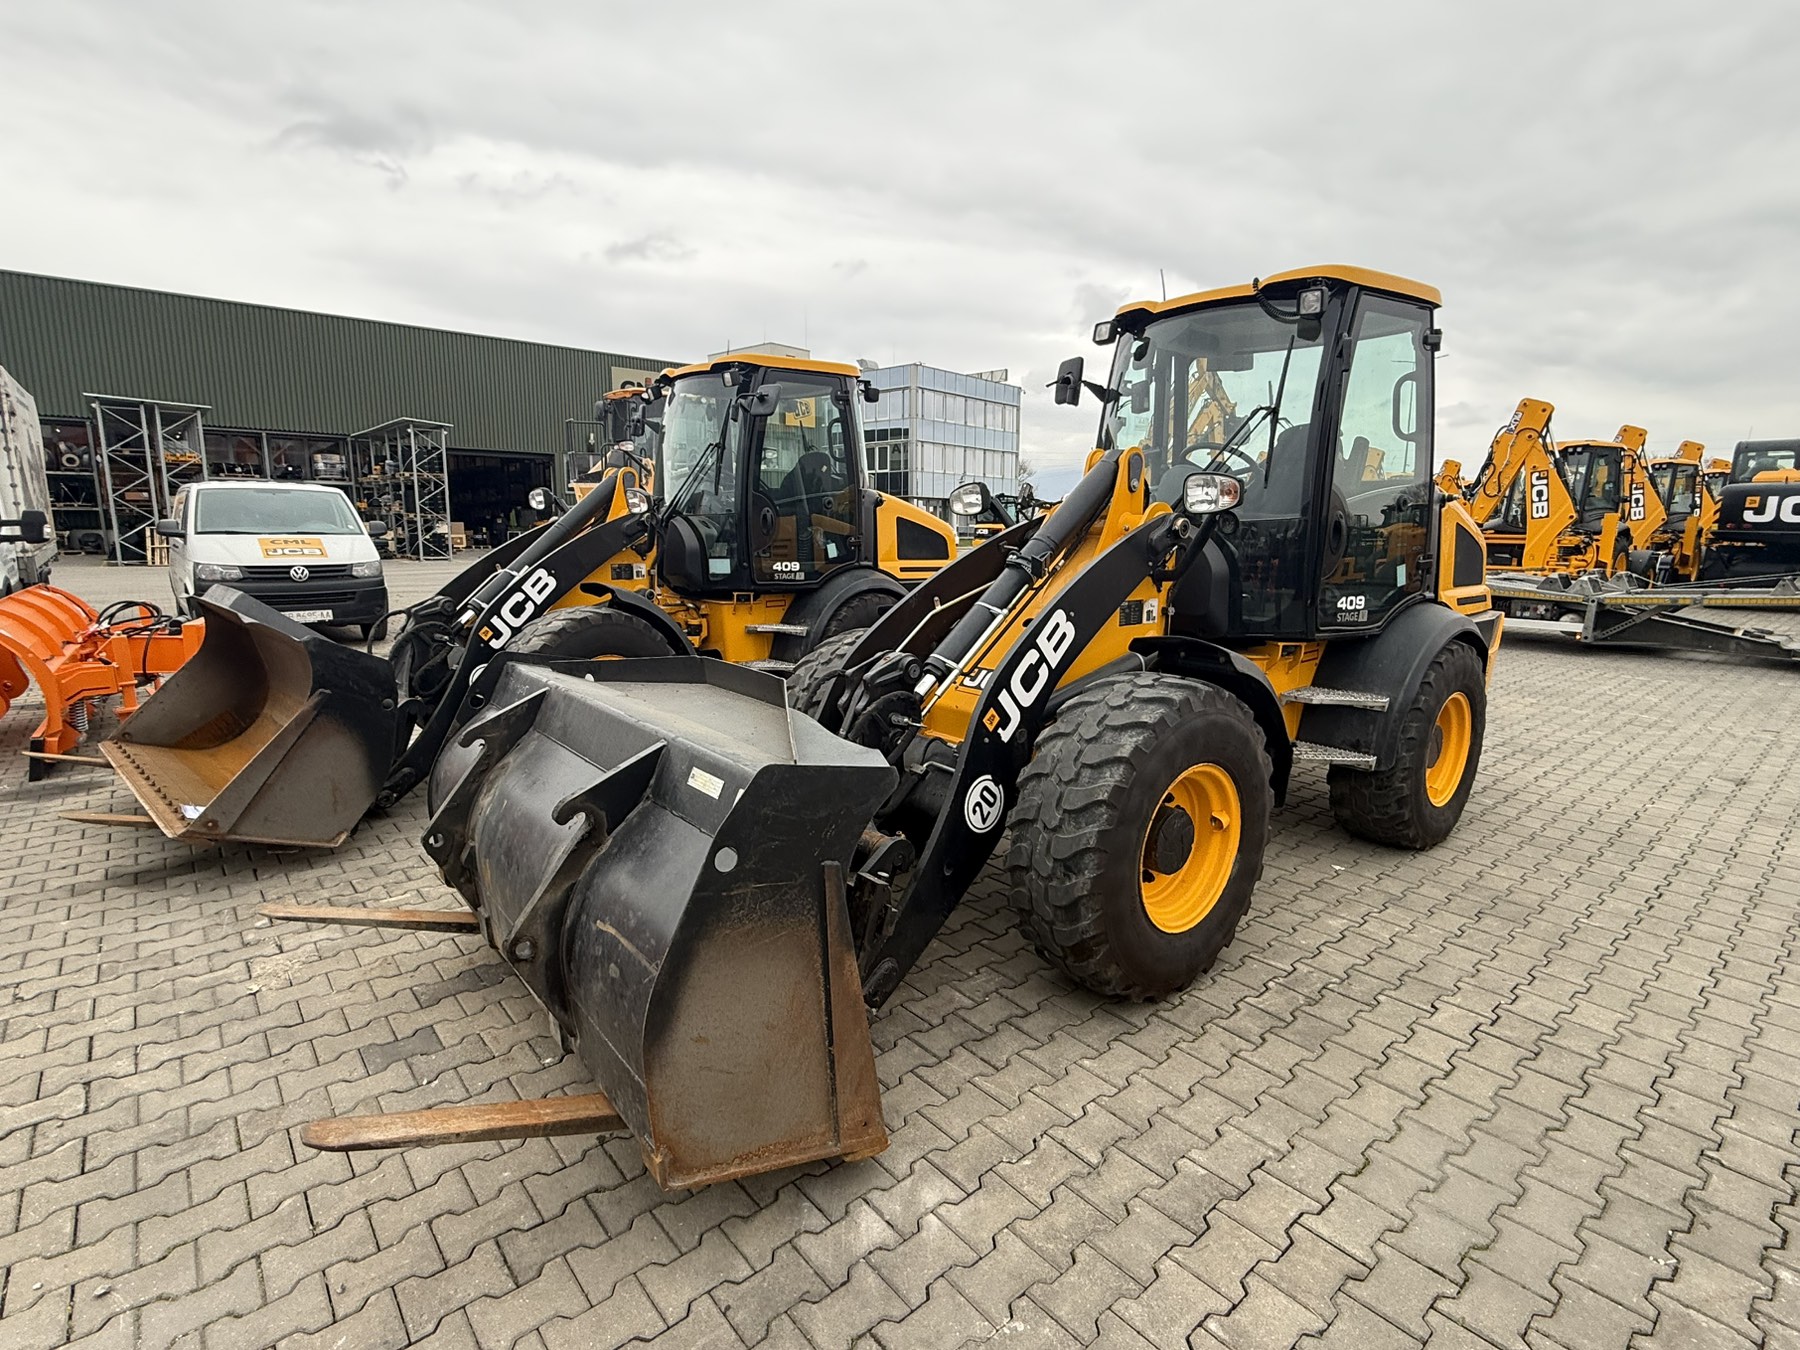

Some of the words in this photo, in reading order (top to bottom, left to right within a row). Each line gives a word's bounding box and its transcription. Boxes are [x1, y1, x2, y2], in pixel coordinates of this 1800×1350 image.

[1531, 472, 1549, 518] JCB
[1630, 483, 1645, 520] JCB
[265, 548, 323, 556] JCB
[772, 561, 800, 571] 409
[774, 572, 796, 580] STAGE
[488, 567, 557, 650] JCB
[1336, 595, 1365, 610] 409
[1336, 611, 1358, 622] STAGE
[997, 608, 1076, 744] JCB
[972, 784, 998, 825] 20
